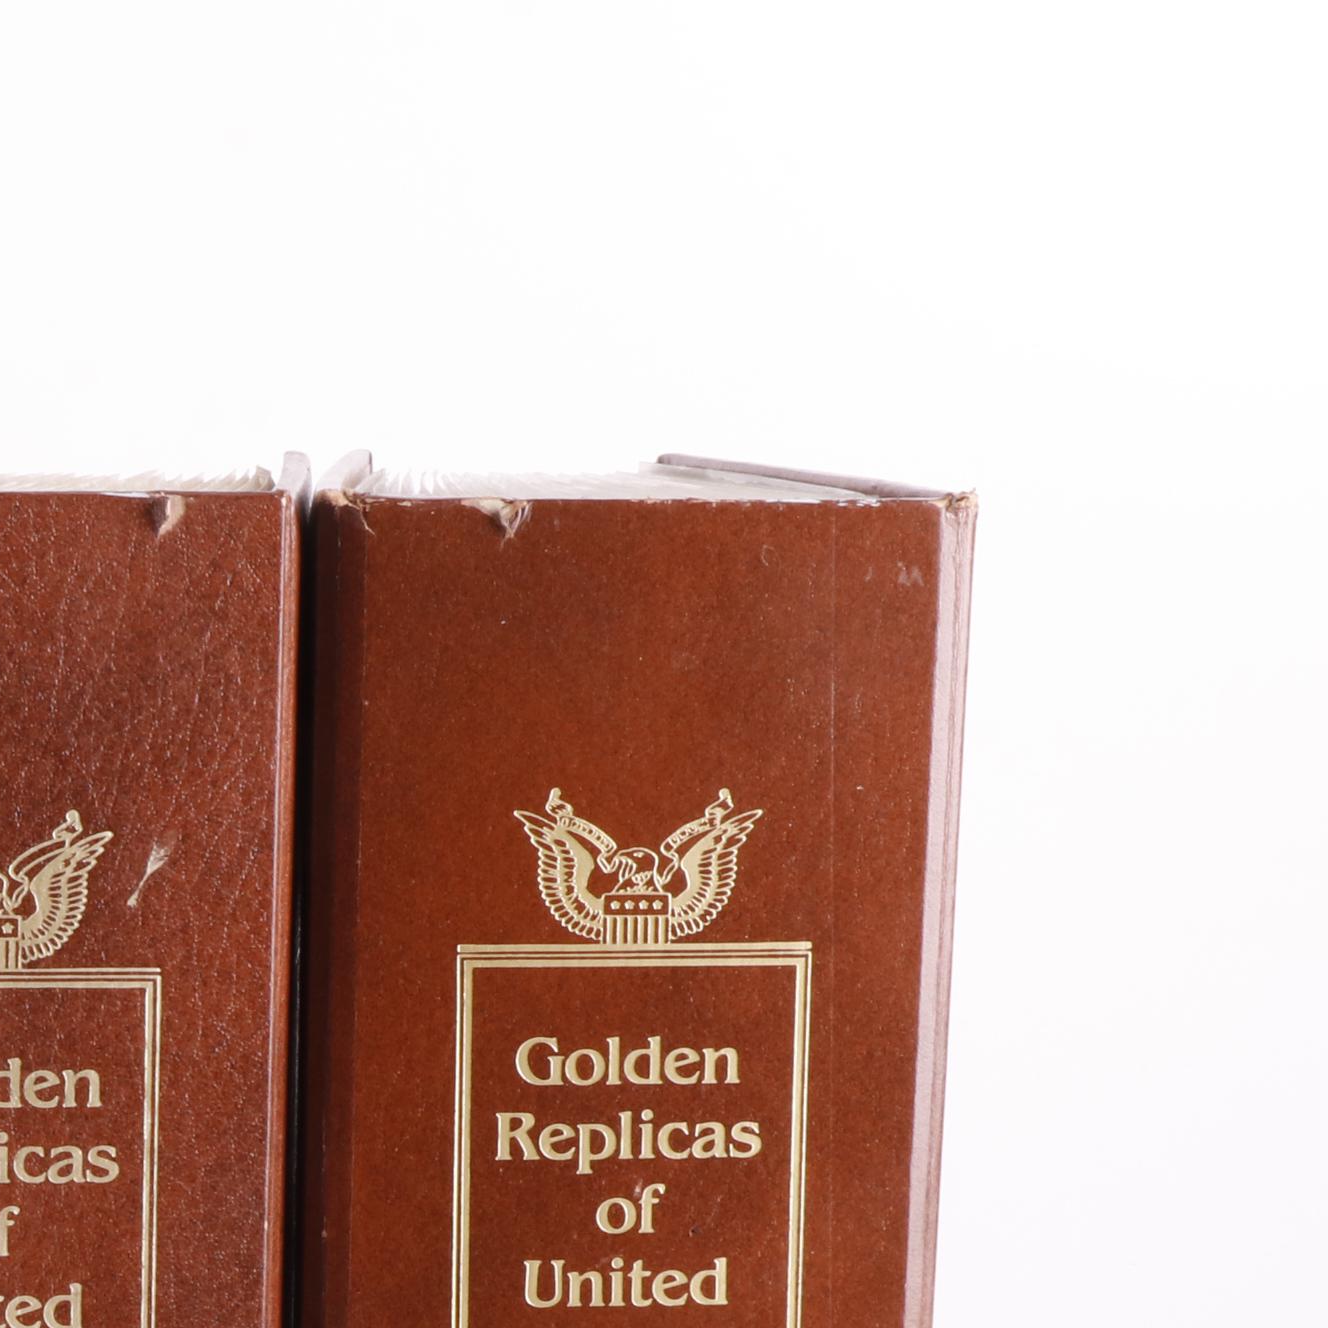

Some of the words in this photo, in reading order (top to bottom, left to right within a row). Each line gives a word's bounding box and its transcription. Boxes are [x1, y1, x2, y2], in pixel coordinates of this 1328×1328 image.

[515, 1035, 740, 1086] Golden
[495, 1109, 762, 1174] Replicas
[596, 1183, 666, 1234] of
[524, 1257, 728, 1308] United
